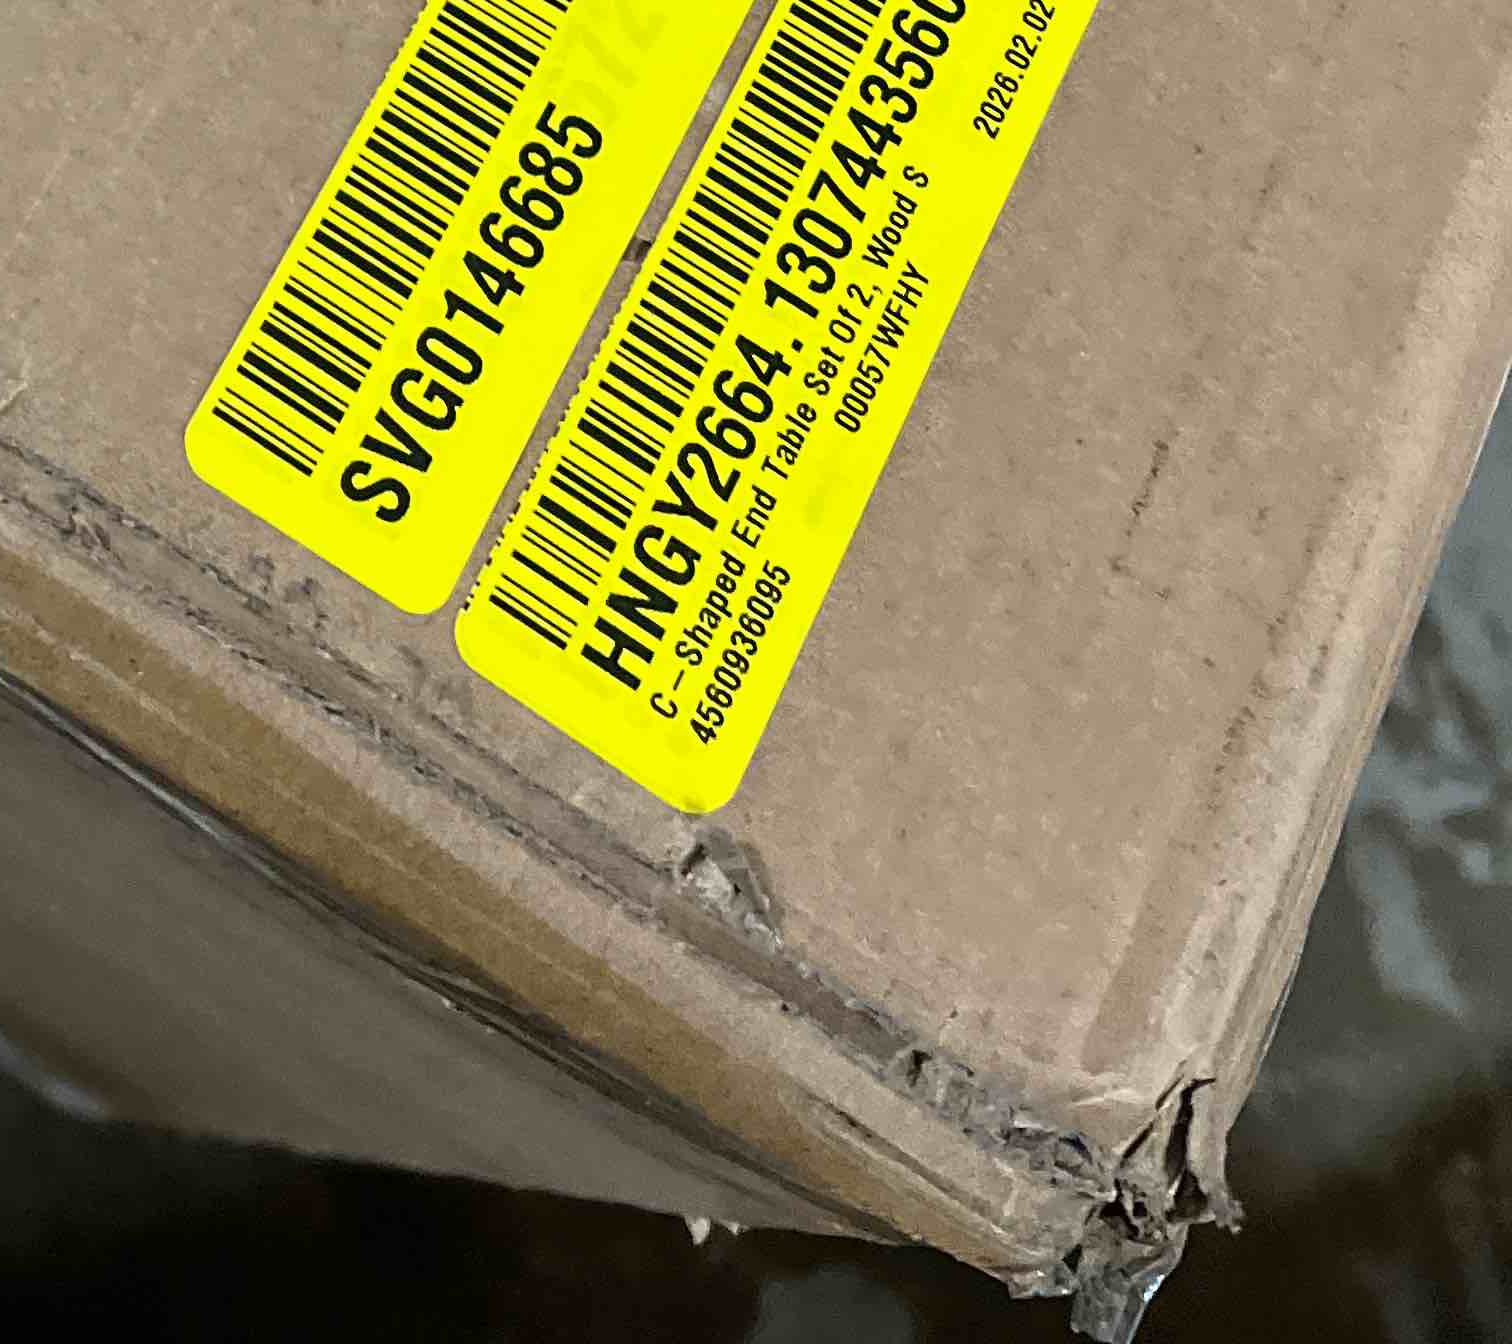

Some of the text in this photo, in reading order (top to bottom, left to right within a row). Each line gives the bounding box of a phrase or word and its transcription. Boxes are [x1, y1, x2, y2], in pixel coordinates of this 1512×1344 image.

[903, 166, 928, 187] S
[862, 191, 917, 269] Wood
[341, 102, 602, 522] SVG0146685
[829, 305, 861, 343] Of
[847, 284, 881, 307] 2,
[804, 347, 844, 395] Set
[835, 261, 928, 432] 00057WFHY
[762, 403, 816, 479] Table
[731, 485, 776, 548] End
[691, 560, 790, 744] 4560936095
